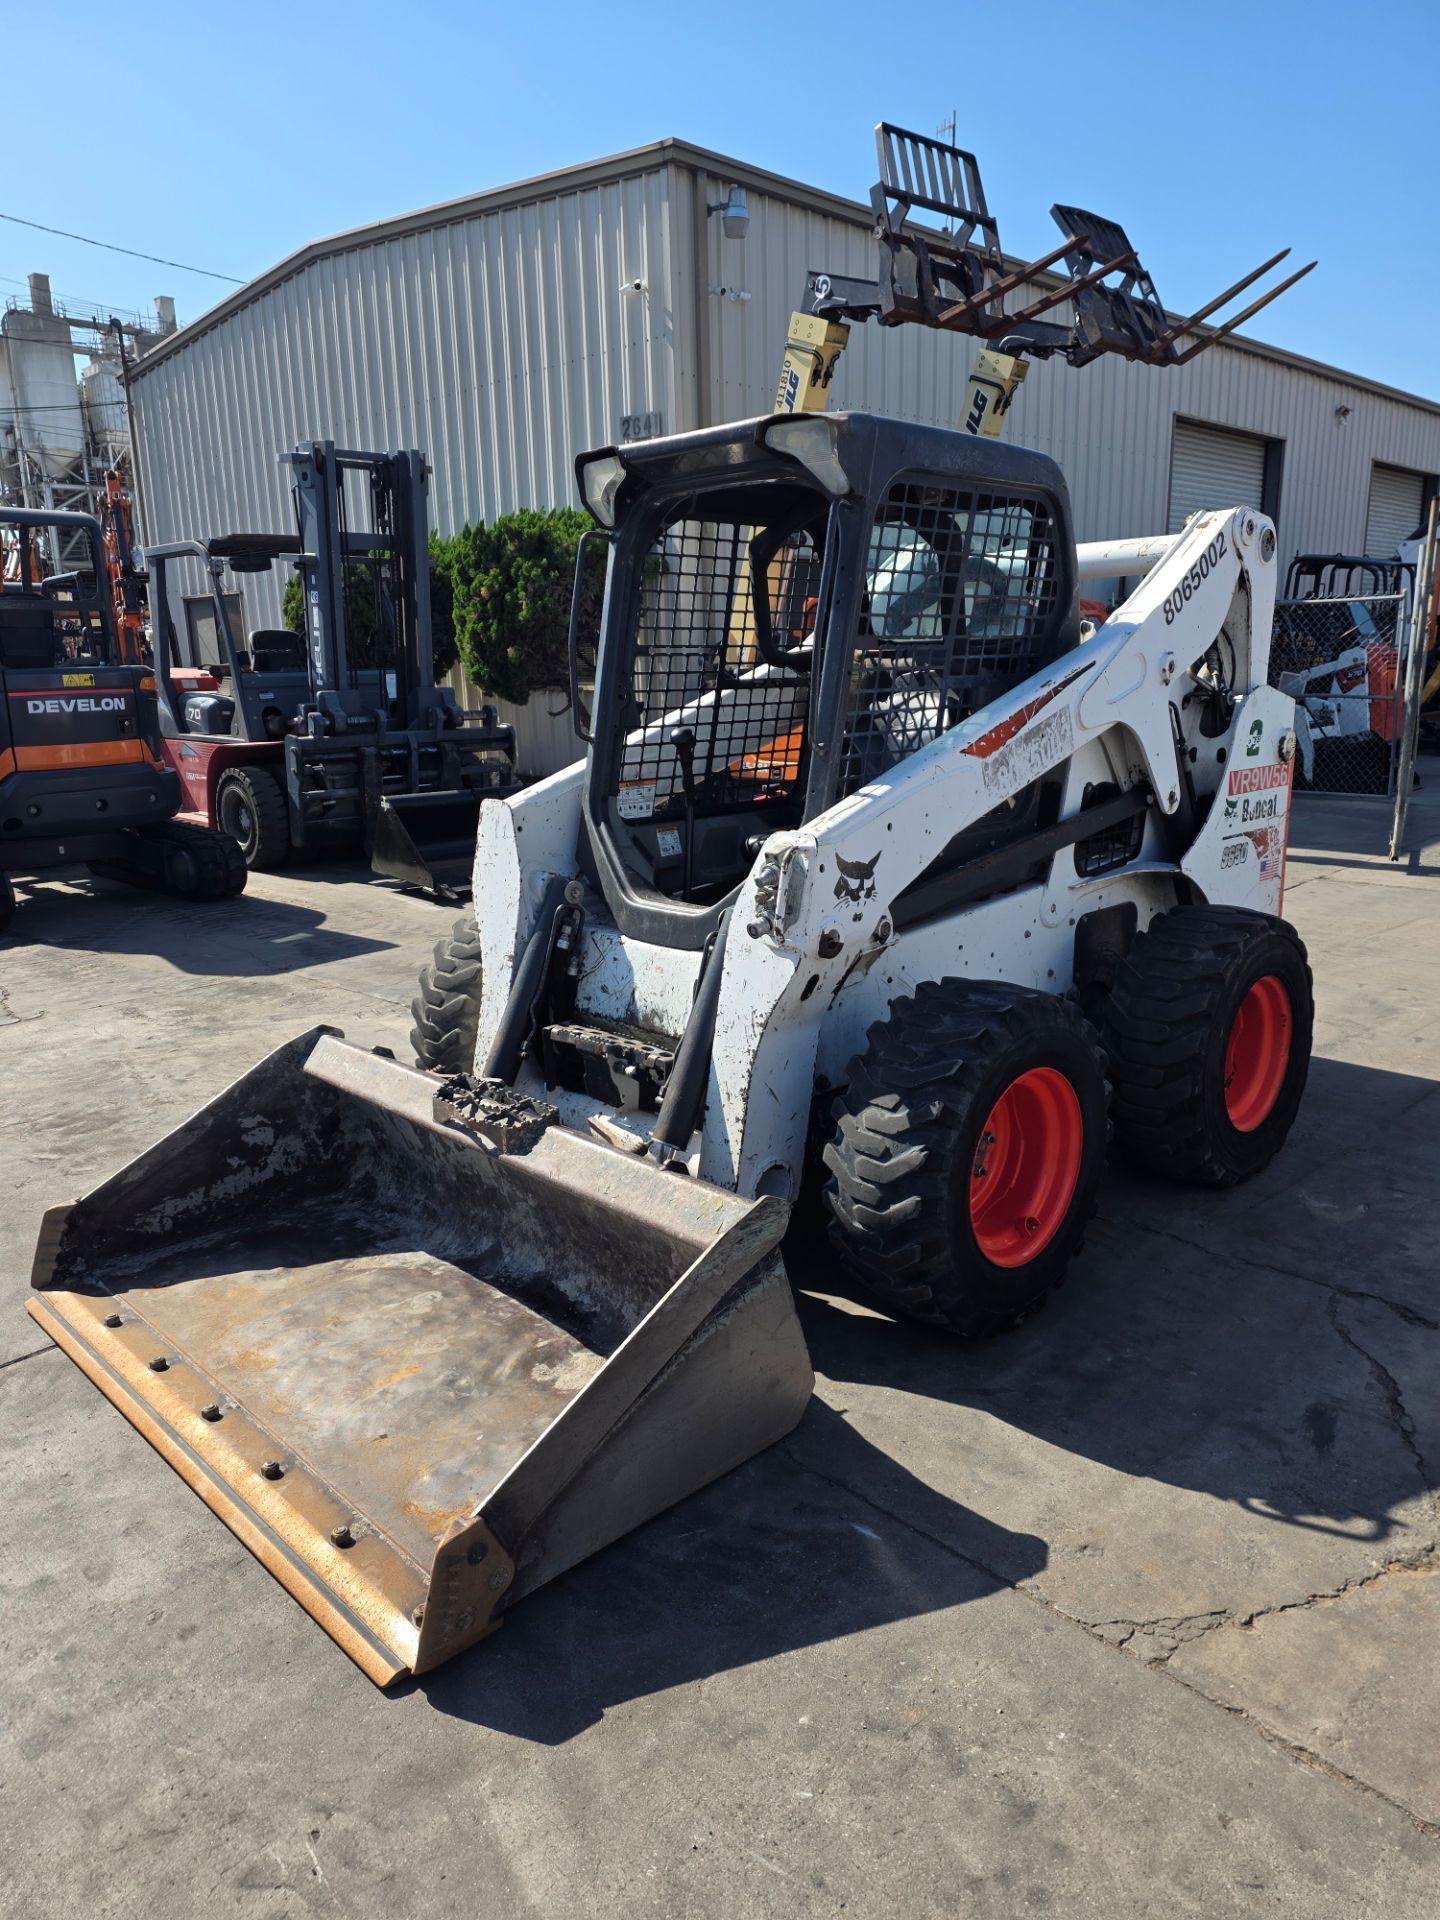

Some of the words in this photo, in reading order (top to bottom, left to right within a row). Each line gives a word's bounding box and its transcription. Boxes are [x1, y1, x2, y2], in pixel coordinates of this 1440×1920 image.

[775, 359, 792, 409] 411810
[784, 368, 800, 413] JLG
[621, 411, 663, 440] 2641
[1163, 531, 1228, 626] 8065002
[27, 697, 126, 714] DEVELON
[188, 708, 201, 720] 70
[1230, 764, 1288, 796] VR9W56
